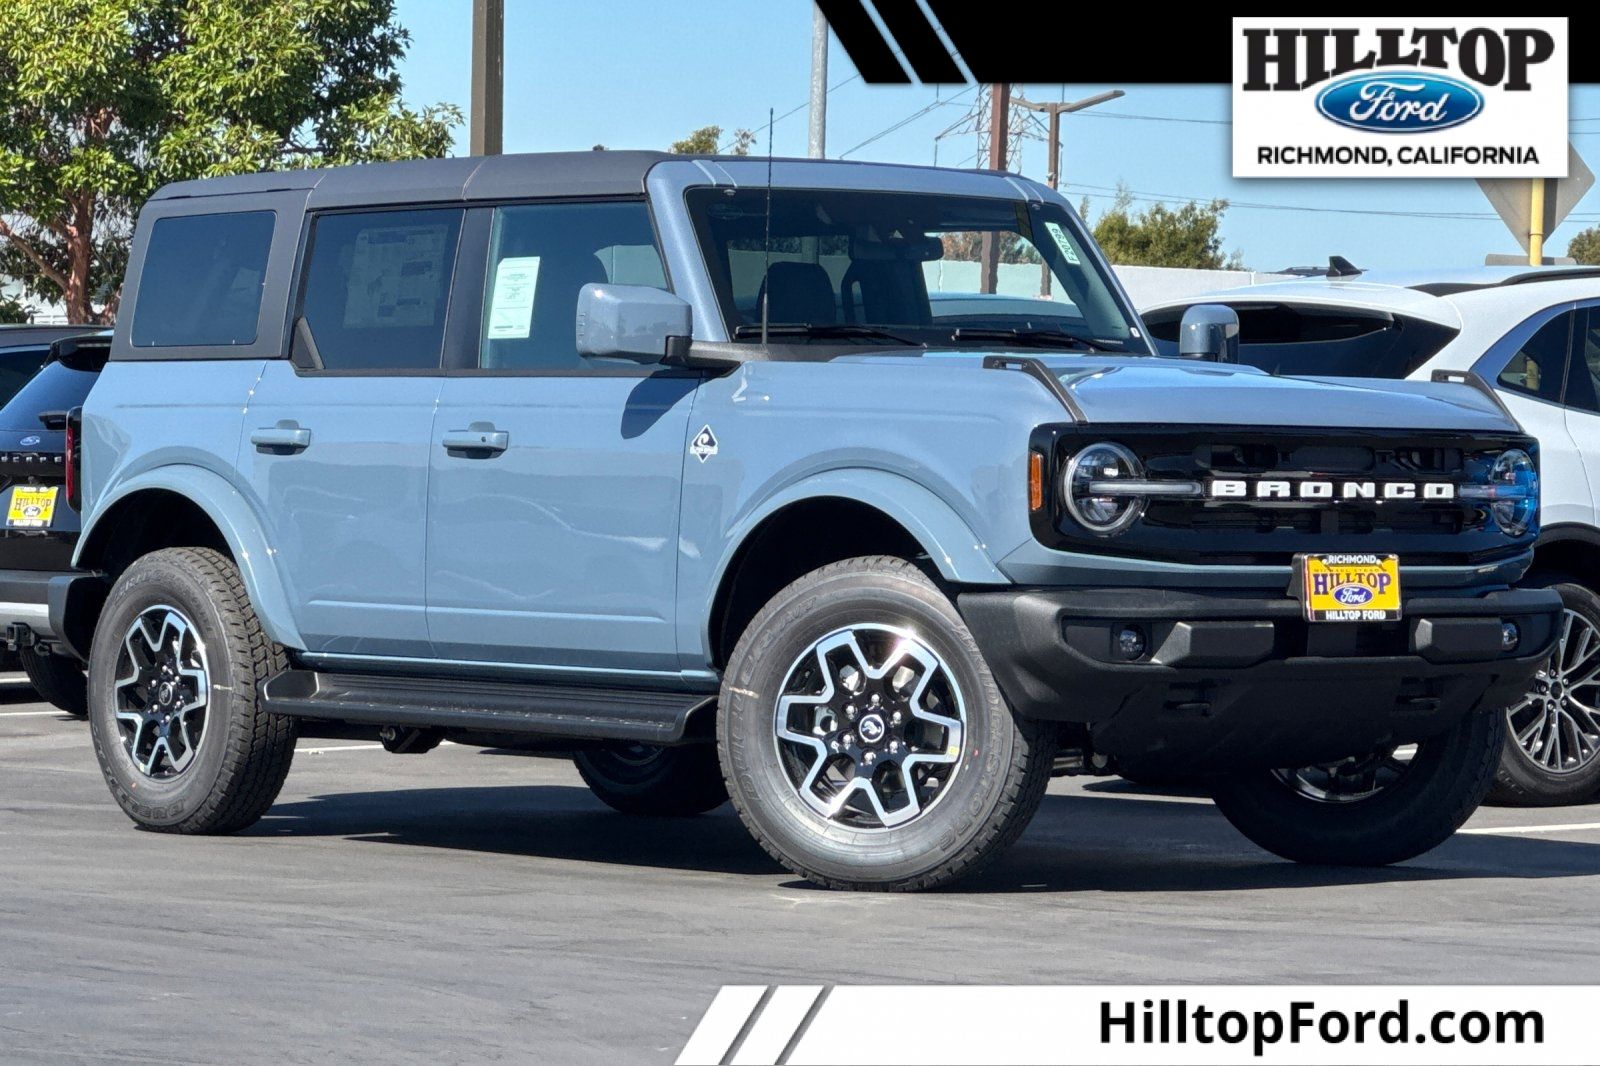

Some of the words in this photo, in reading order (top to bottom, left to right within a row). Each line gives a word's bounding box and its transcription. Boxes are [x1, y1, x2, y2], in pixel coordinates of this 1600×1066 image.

[1212, 480, 1454, 498] BRONCO
[14, 497, 52, 511] HILLTOP
[1328, 555, 1377, 564] RICHMOND
[1313, 573, 1391, 595] HILLTOP
[1340, 587, 1366, 603] Ford
[1325, 611, 1360, 620] HILLTOP
[1363, 611, 1386, 620] FORD
